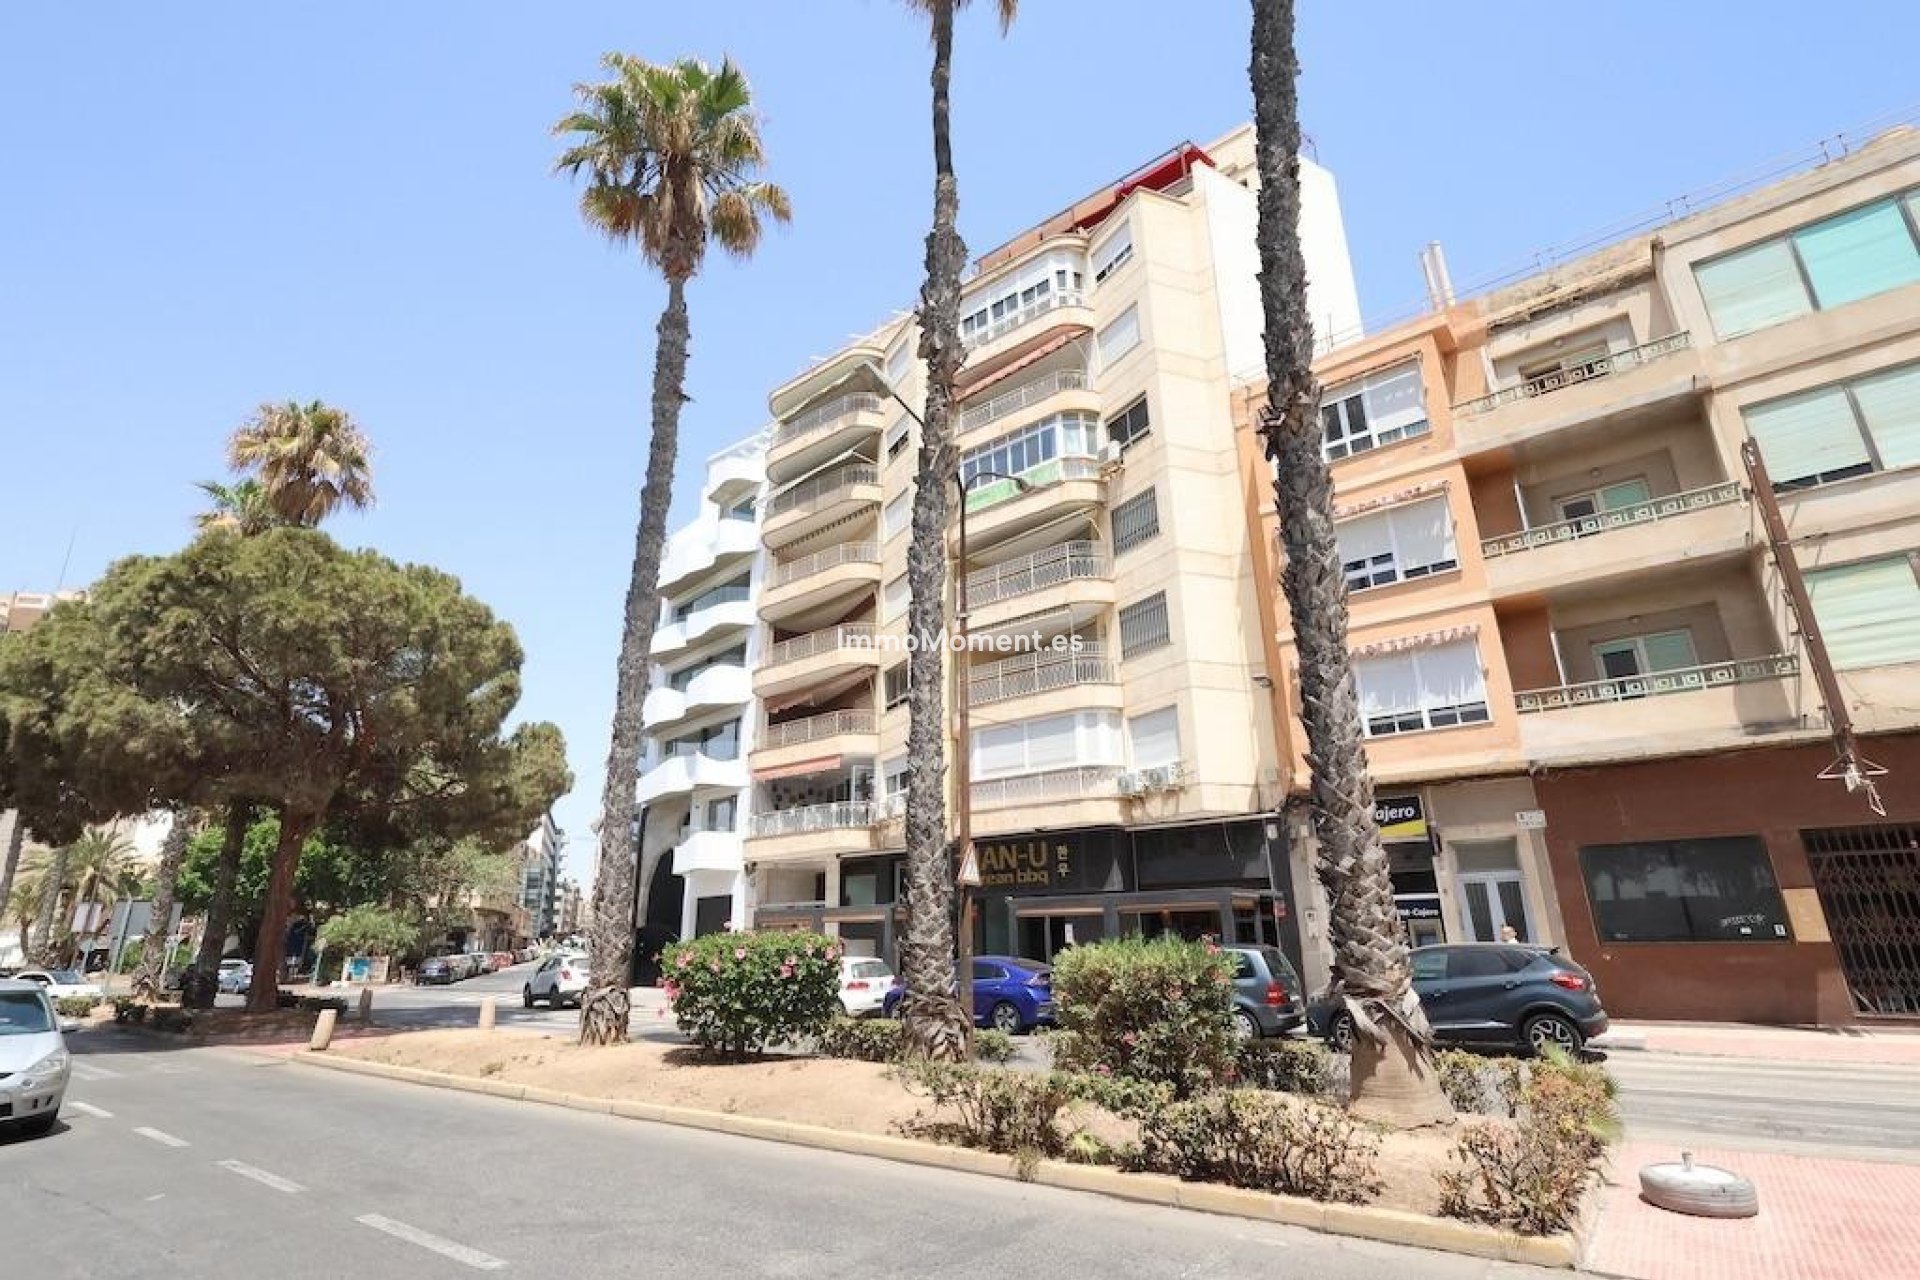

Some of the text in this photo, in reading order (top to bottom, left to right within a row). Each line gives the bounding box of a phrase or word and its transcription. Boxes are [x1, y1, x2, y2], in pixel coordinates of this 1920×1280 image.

[1375, 805, 1415, 822] ajero
[977, 841, 1048, 870] AN-U
[1017, 867, 1049, 885] bbq
